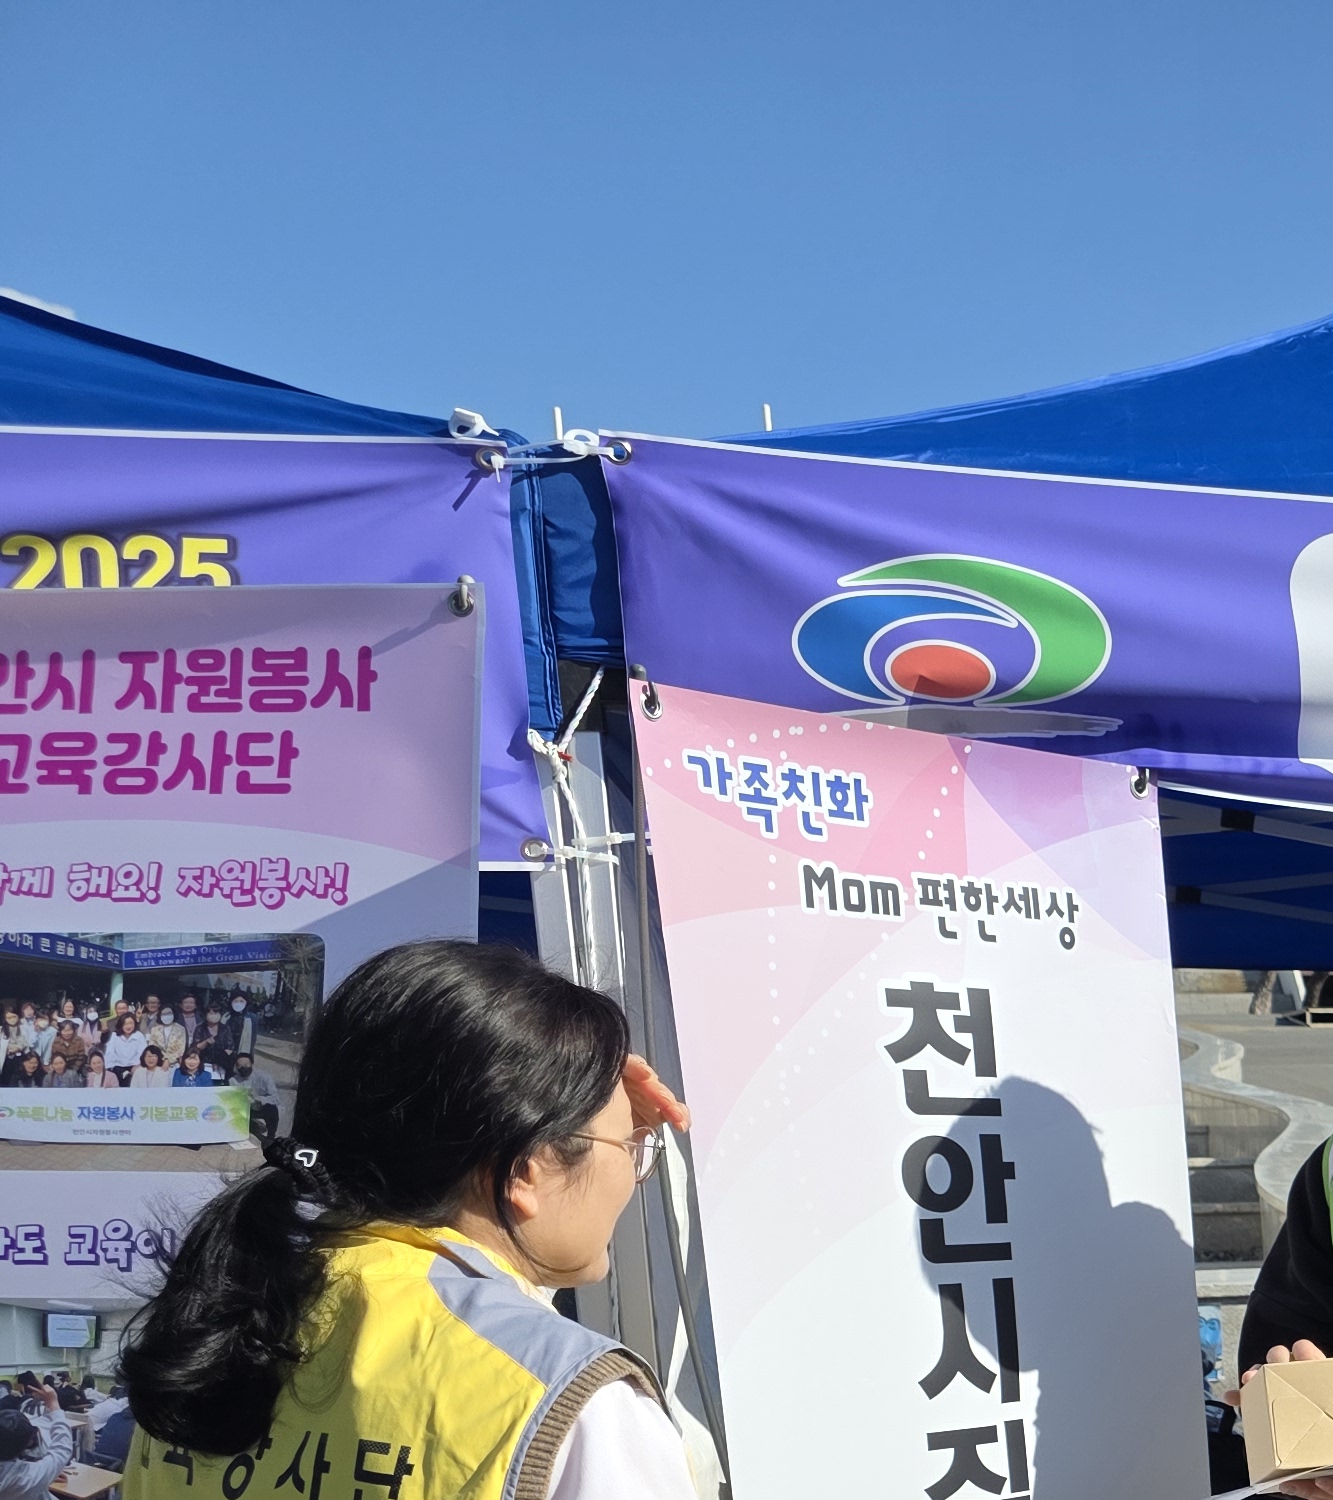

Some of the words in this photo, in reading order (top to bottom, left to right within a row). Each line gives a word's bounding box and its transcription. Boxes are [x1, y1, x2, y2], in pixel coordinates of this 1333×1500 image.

[2, 533, 235, 590] 2025
[115, 645, 379, 714] 자원봉사
[685, 753, 870, 836] 가족친화
[0, 862, 54, 906] 께
[67, 862, 163, 905] 해요!
[177, 857, 349, 911] 자원봉사!
[803, 865, 902, 918] Mom
[917, 875, 1080, 951] 편한세상
[0, 932, 34, 950] 하며
[40, 937, 51, 953] 큰
[134, 950, 172, 960] Embrace
[175, 947, 197, 957] Each
[216, 952, 244, 962] Great
[247, 950, 282, 961] Vision
[77, 1105, 136, 1122] 자원봉사
[140, 1105, 199, 1123] 기본교육
